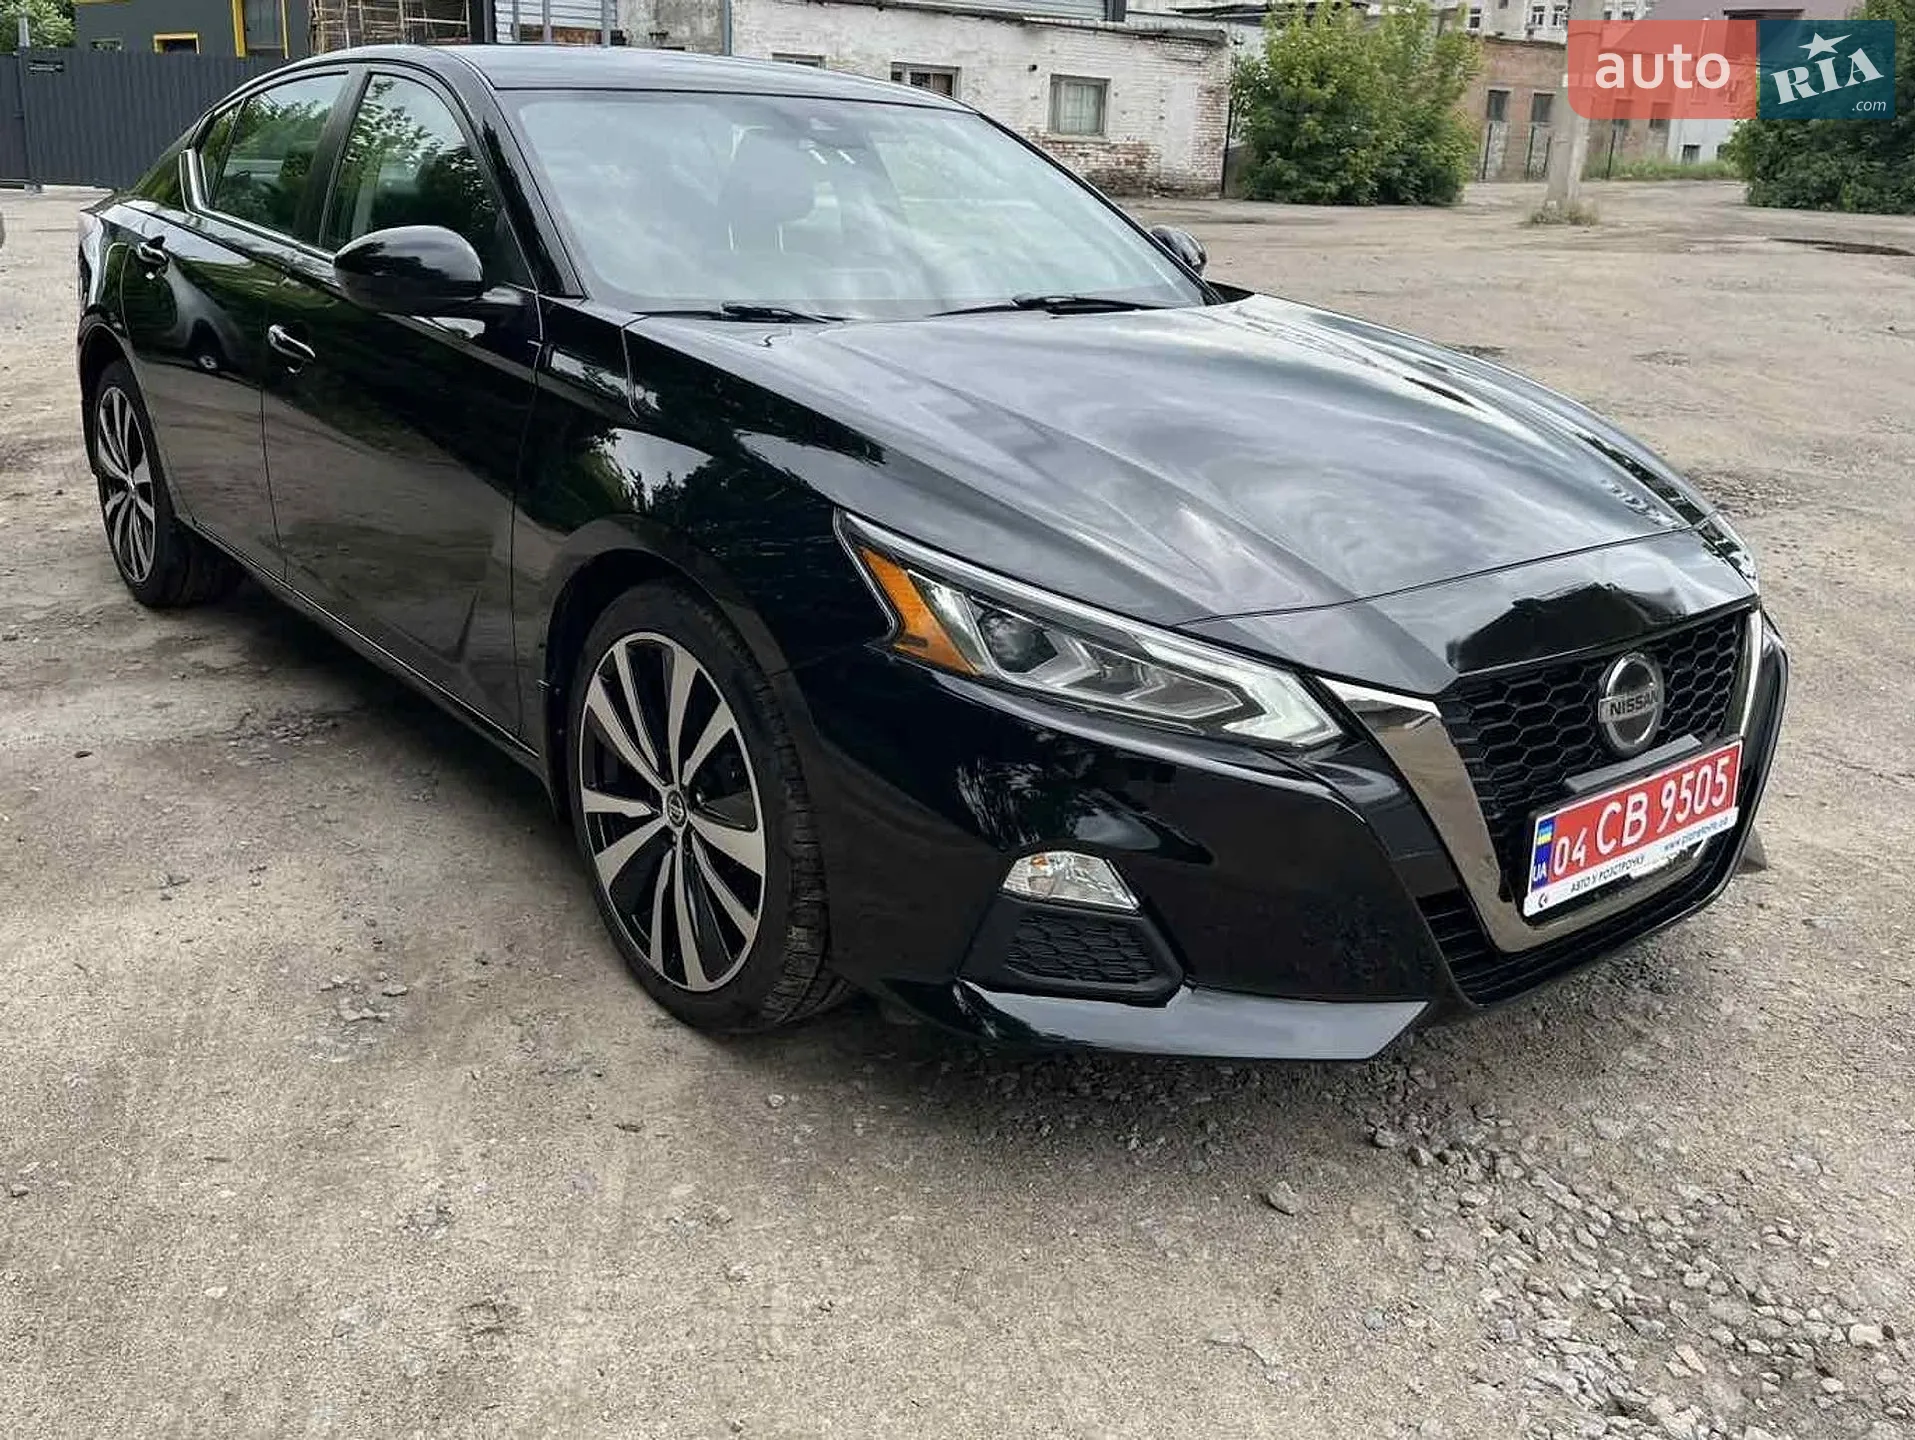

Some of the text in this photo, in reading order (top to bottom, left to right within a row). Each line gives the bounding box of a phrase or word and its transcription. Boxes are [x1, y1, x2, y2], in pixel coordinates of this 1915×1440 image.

[1610, 688, 1659, 716] NISSAN
[1554, 827, 1588, 876] 04
[1656, 756, 1731, 833] 9505
[1532, 861, 1548, 882] UA
